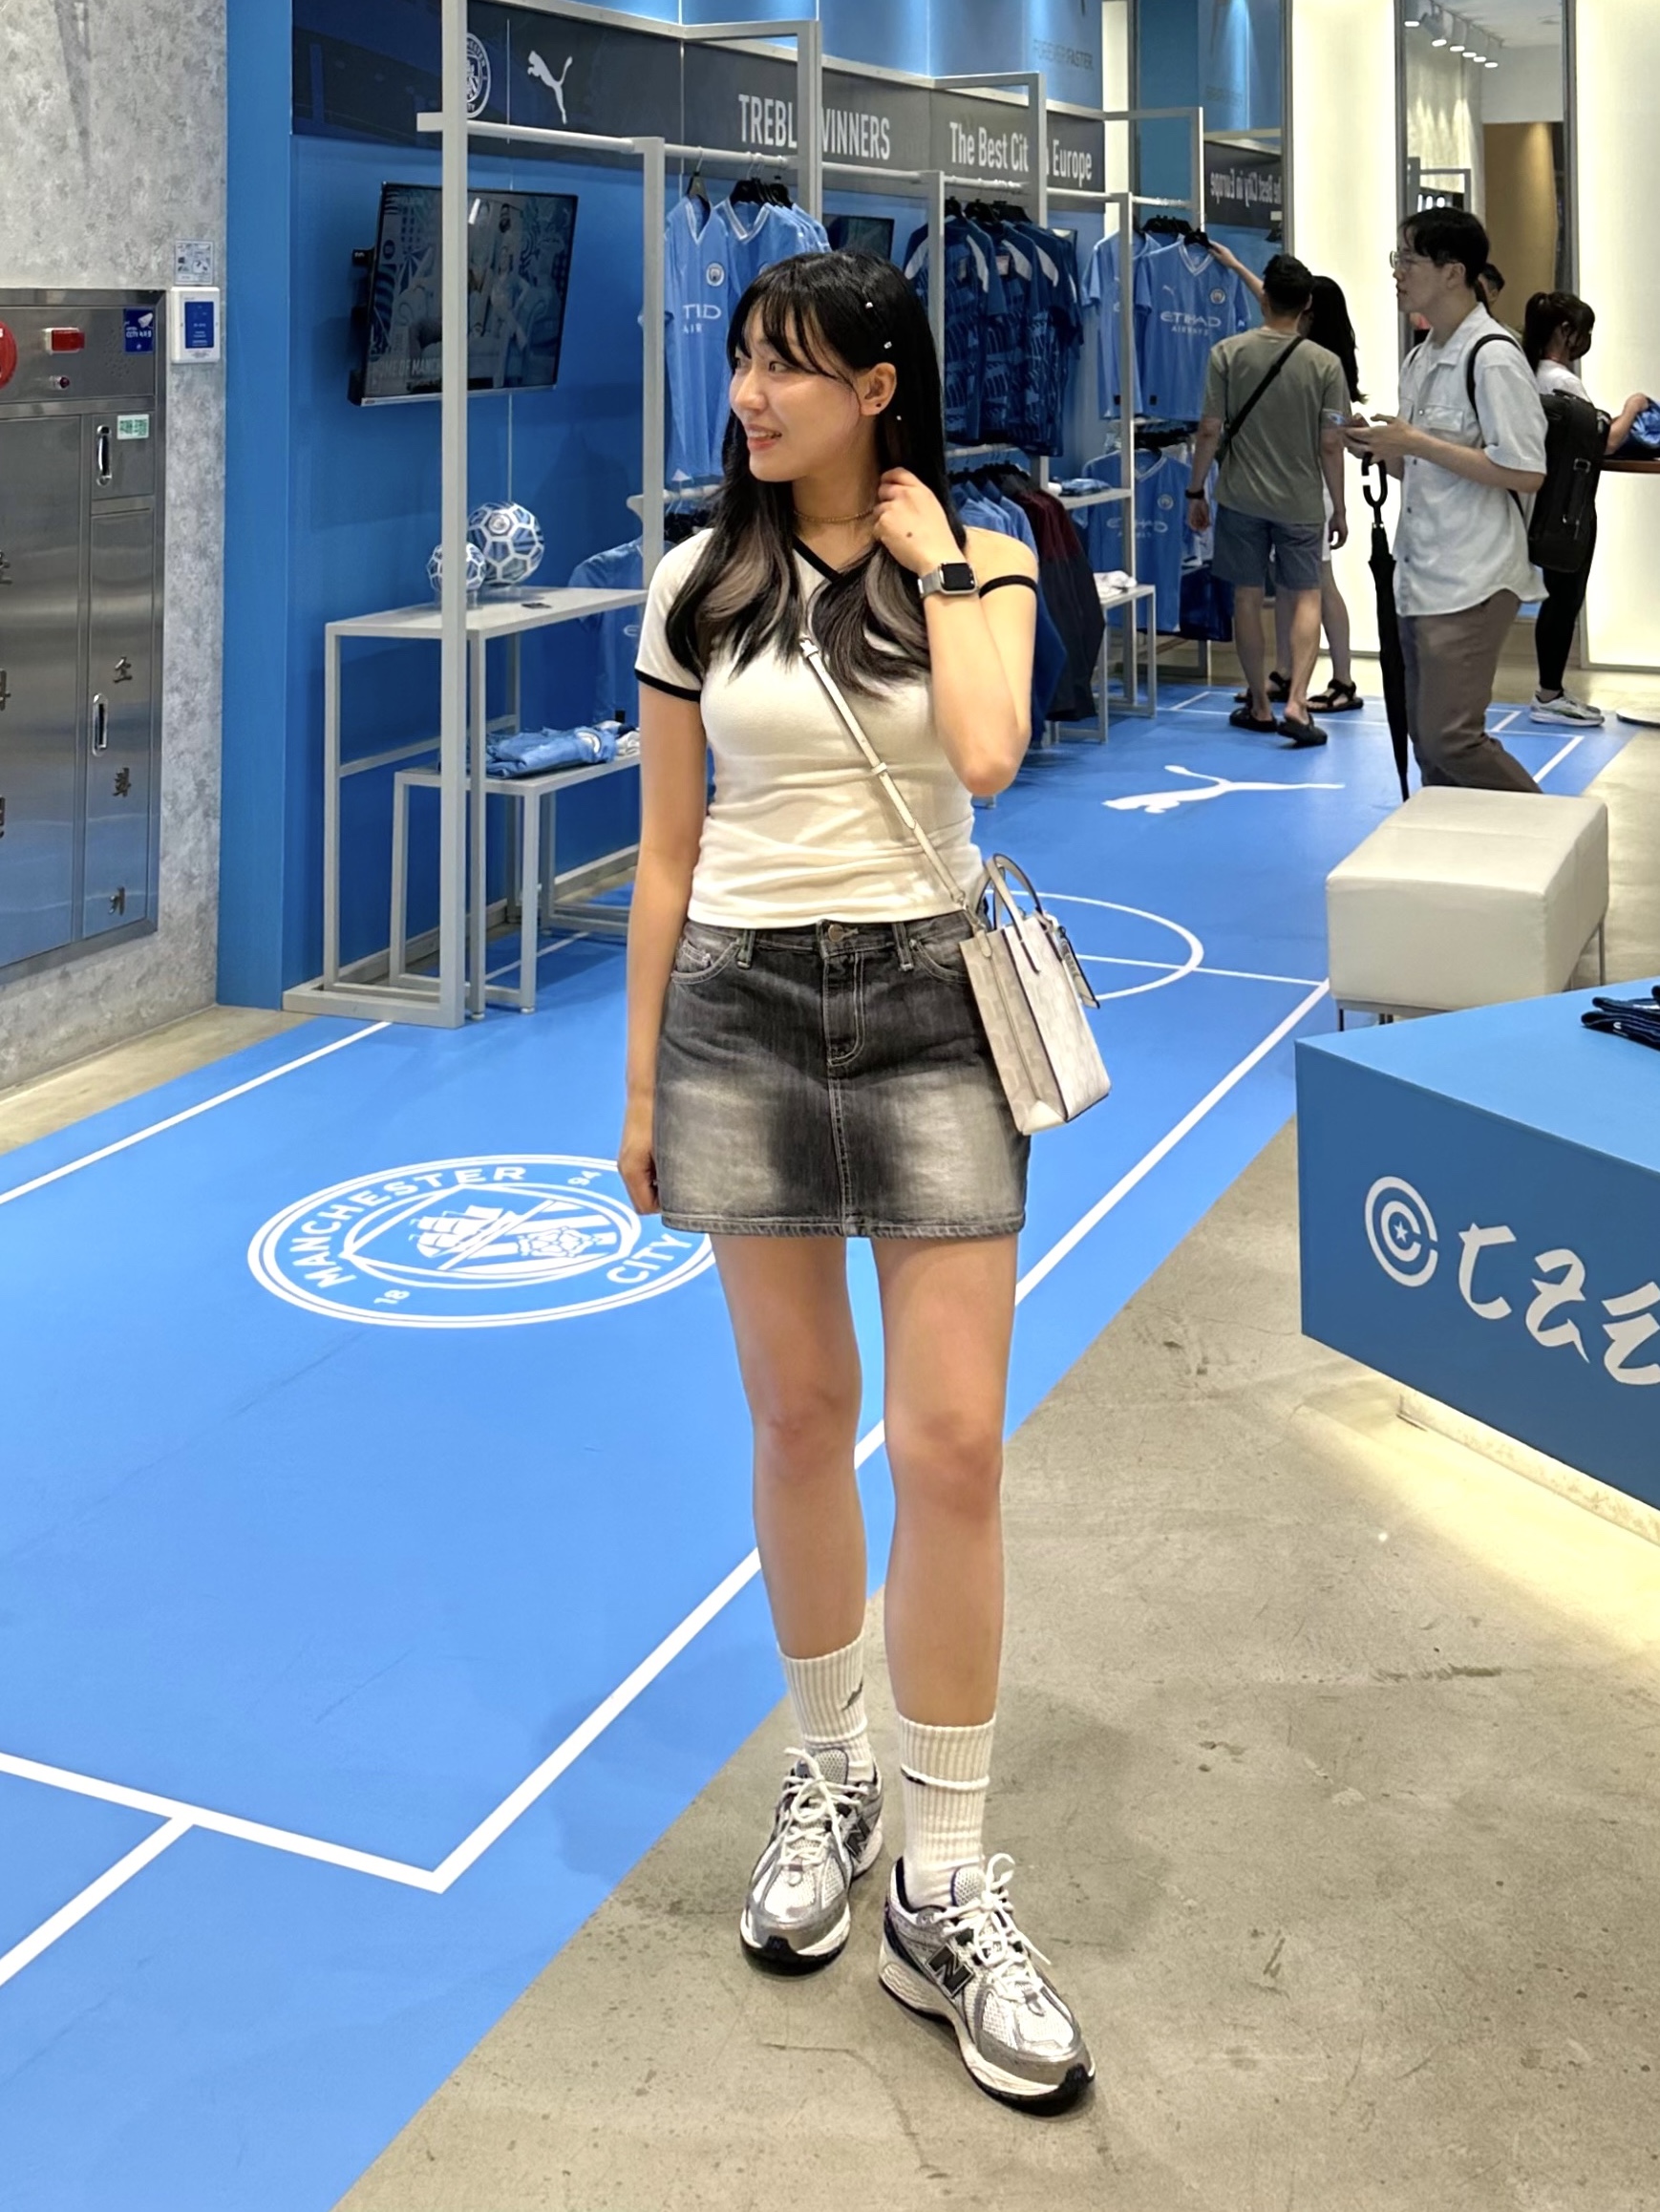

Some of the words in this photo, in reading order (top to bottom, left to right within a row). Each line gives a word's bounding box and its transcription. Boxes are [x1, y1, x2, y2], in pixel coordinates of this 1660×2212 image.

[738, 94, 798, 149] TREBL
[949, 121, 975, 165] The
[978, 127, 1009, 170] Best
[1011, 132, 1030, 173] Cit
[1053, 139, 1093, 188] Europe
[1160, 310, 1222, 328] ETIHAD
[288, 1166, 525, 1288] MANCHESTER
[607, 1233, 693, 1284] CITY
[372, 1289, 411, 1305] 18
[926, 1944, 974, 1998] N
